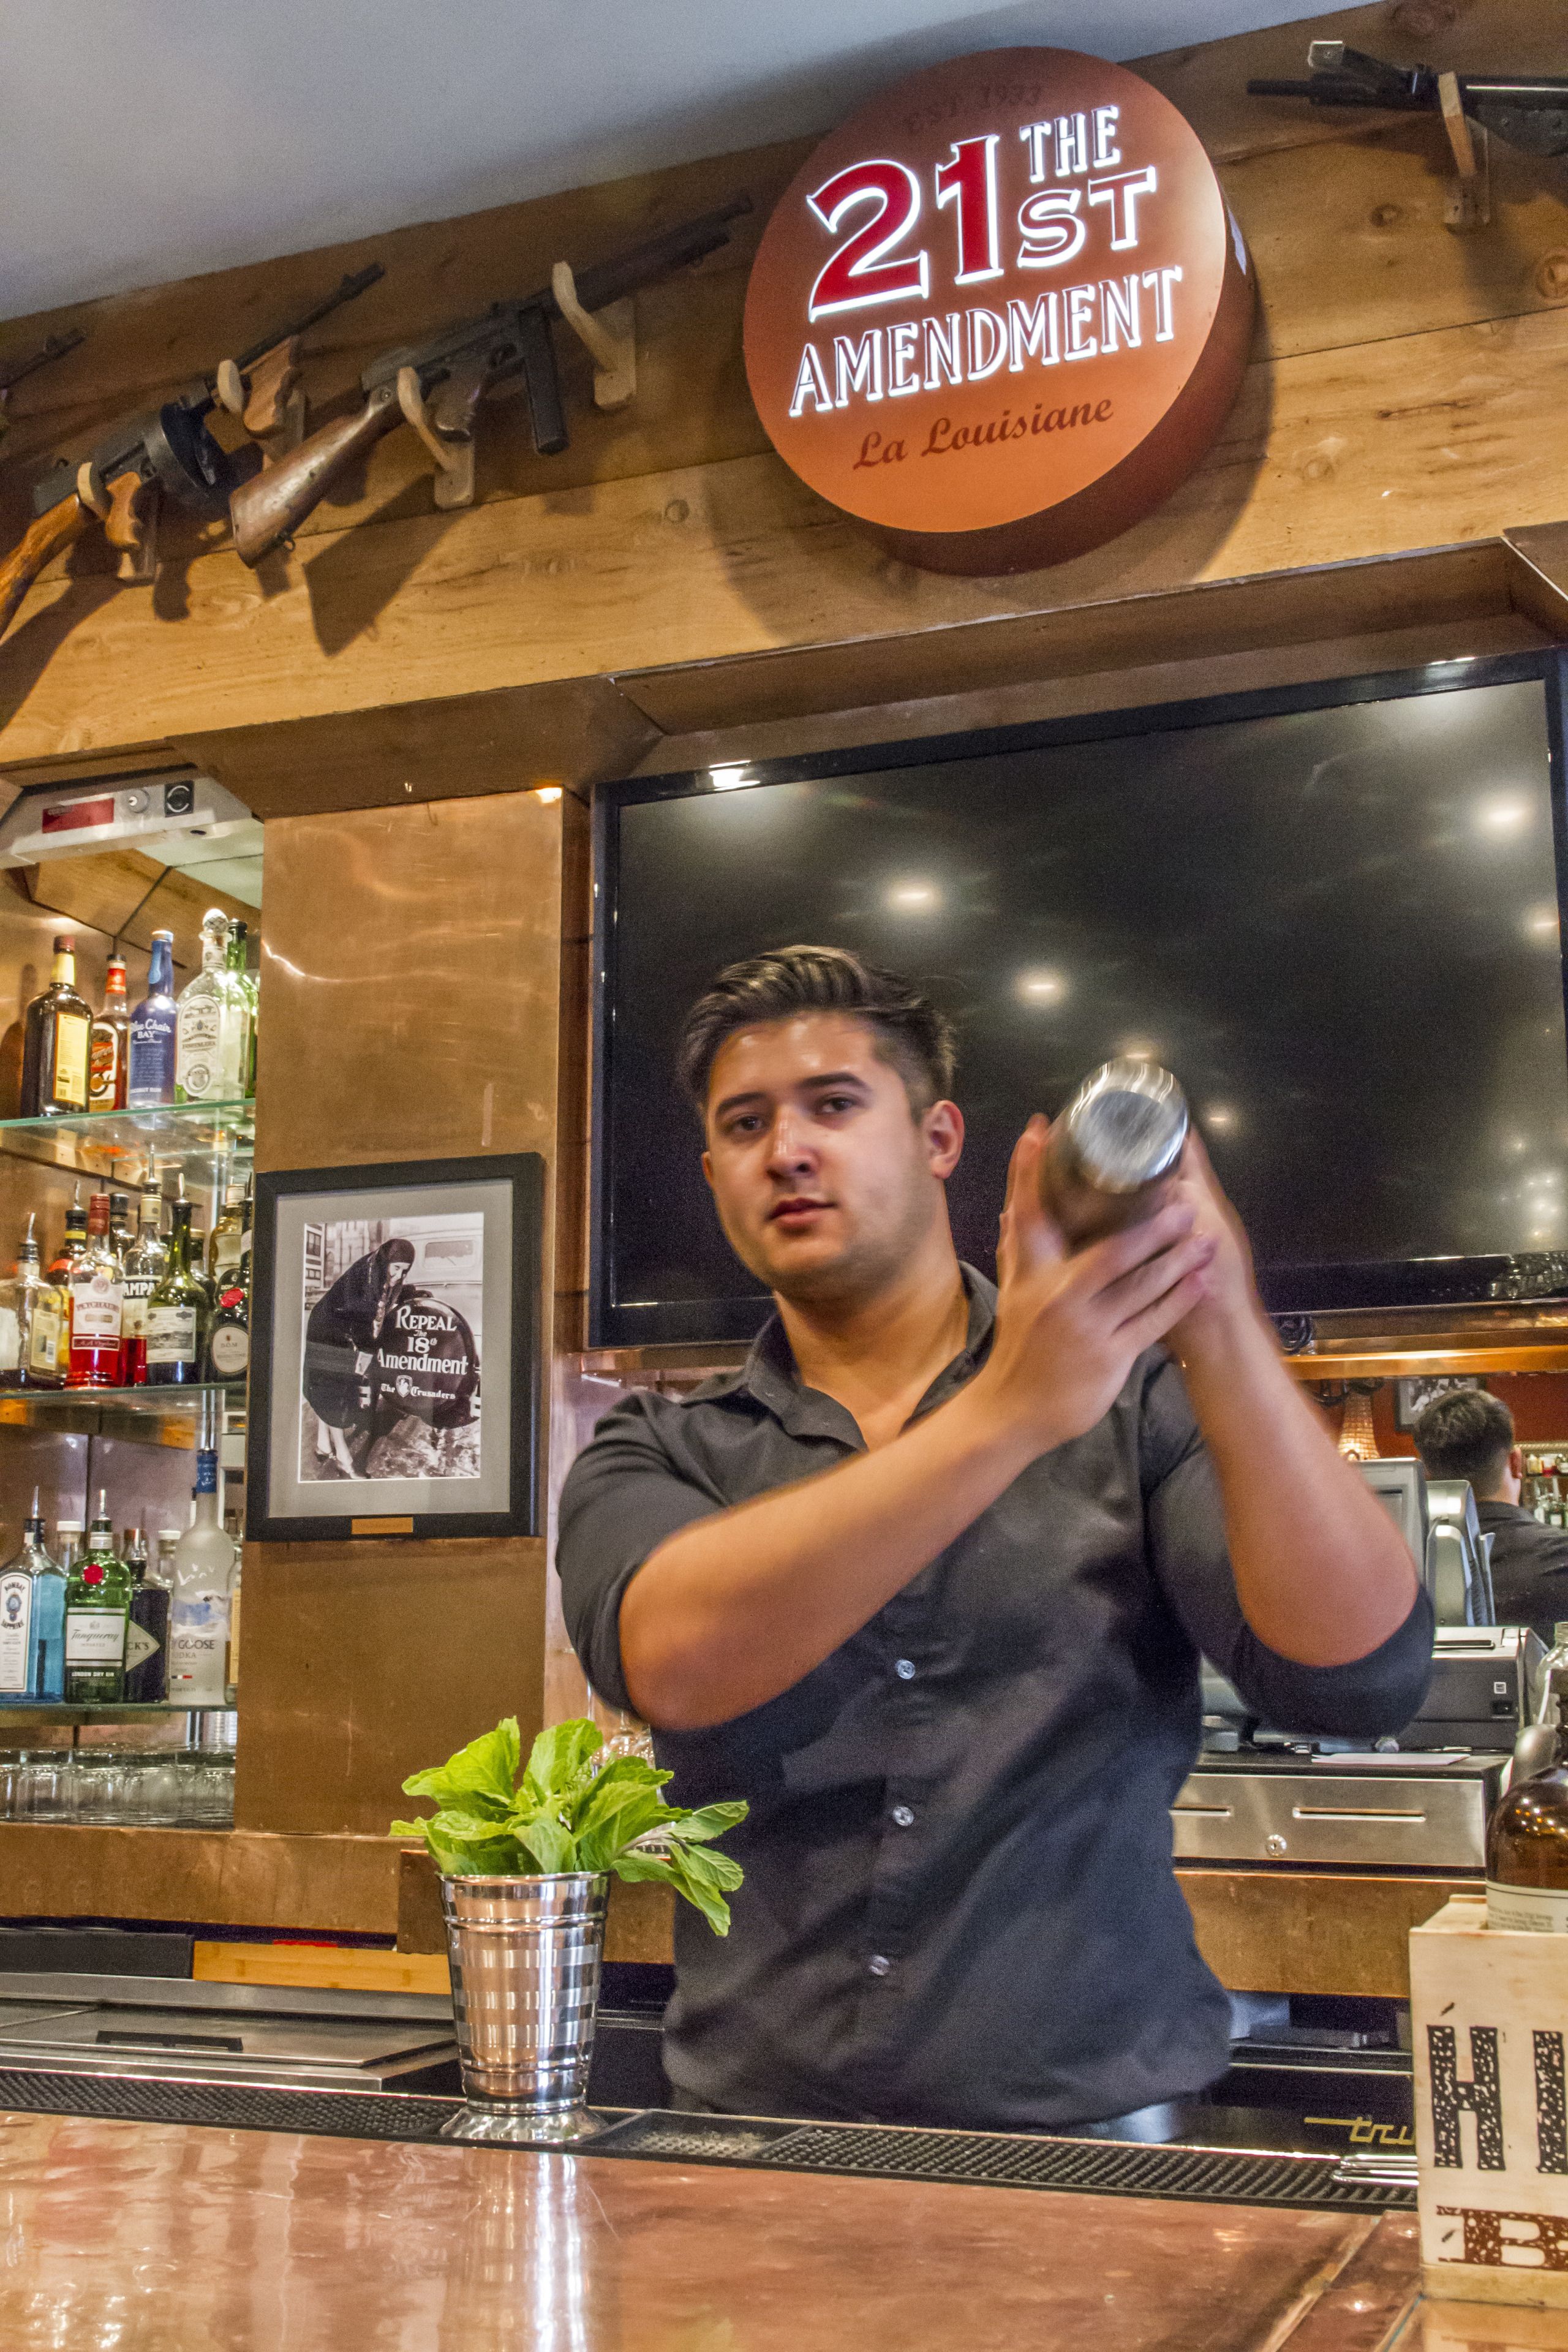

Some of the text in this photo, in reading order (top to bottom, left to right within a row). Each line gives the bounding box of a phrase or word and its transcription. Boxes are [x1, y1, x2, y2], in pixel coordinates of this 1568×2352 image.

[1019, 104, 1120, 182] THE
[806, 134, 1157, 323] 21 ST
[788, 265, 1183, 418] AMENDMENT
[852, 397, 1115, 471] La Louisiane
[137, 1030, 154, 1039] BAY
[396, 1304, 458, 1332] REPEAL
[407, 1336, 438, 1354] 18th
[377, 1348, 469, 1375] Amendment
[380, 1383, 456, 1400] The Crusaders
[4, 1581, 26, 1592] BOMBAY
[71, 1629, 120, 1642] Tanqueray
[178, 1639, 216, 1650] GOOSE
